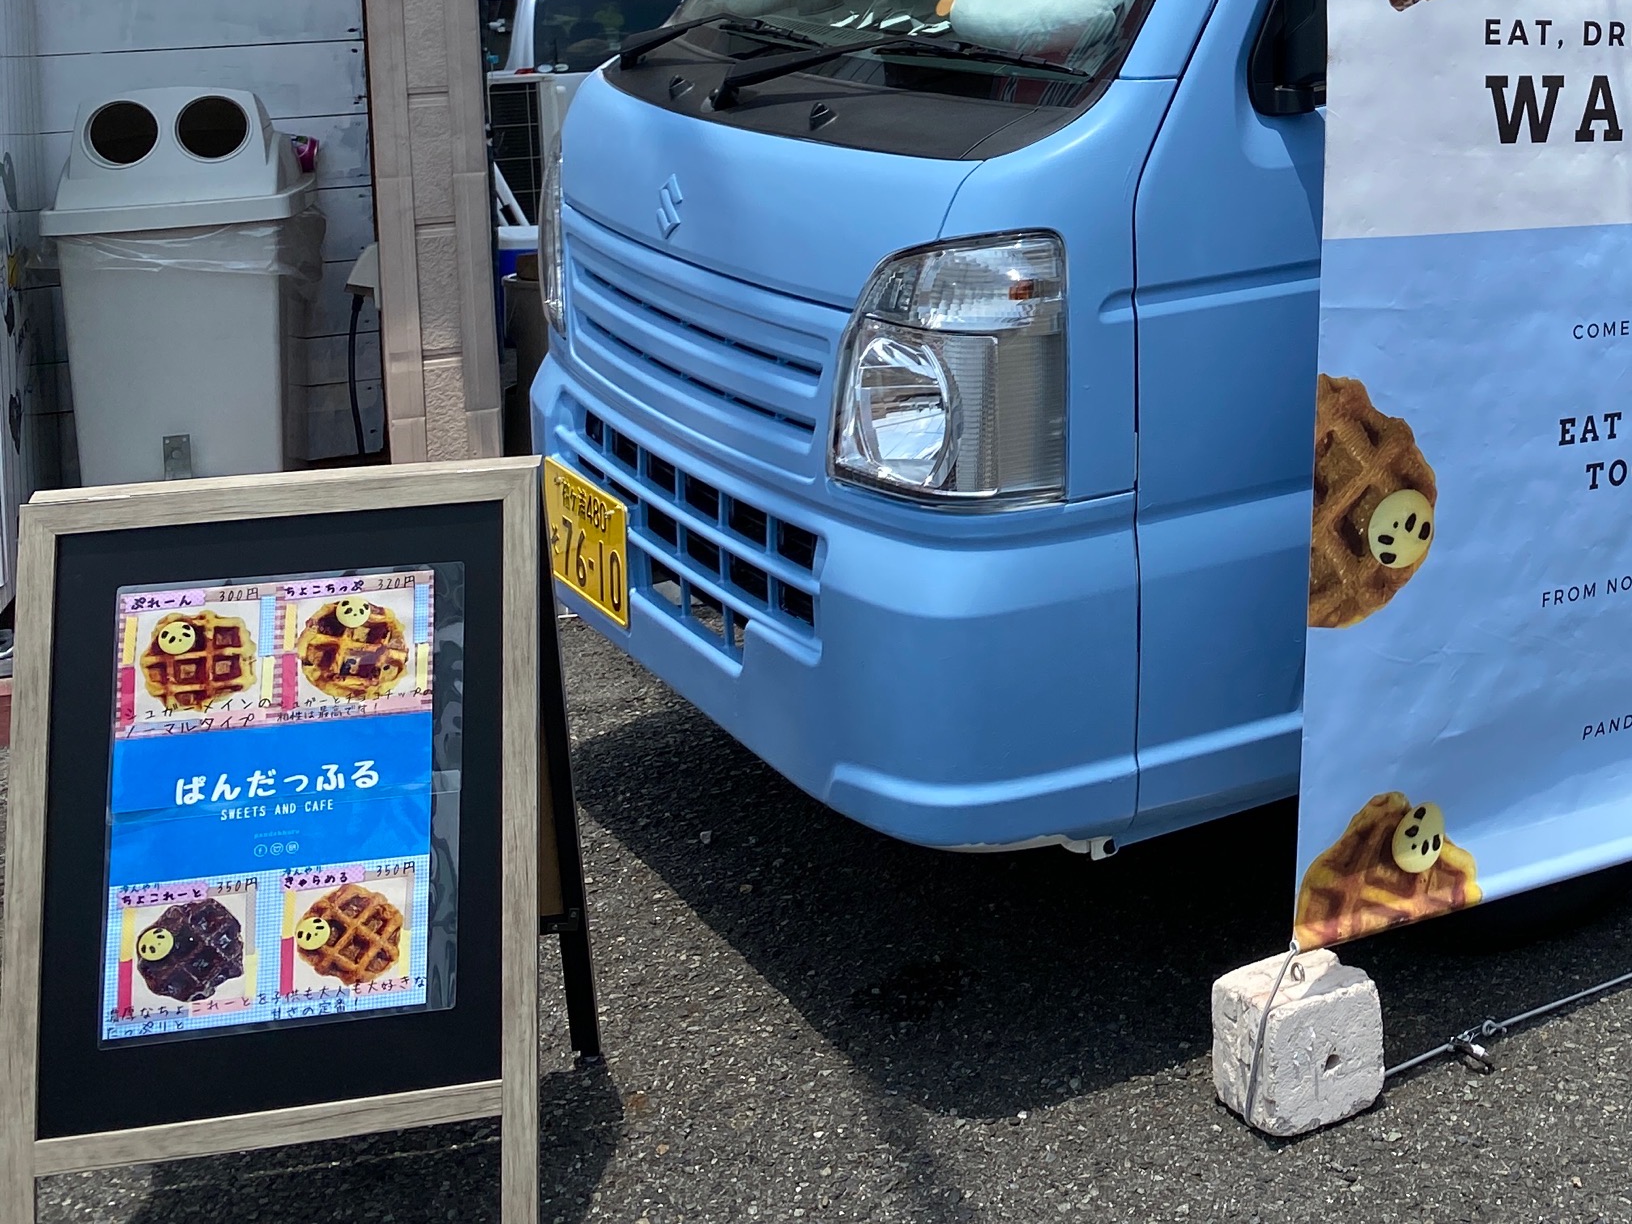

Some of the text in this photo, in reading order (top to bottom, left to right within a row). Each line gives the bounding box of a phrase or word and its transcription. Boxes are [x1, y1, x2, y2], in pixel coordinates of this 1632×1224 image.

[1484, 19, 1564, 50] EAT,
[1572, 319, 1631, 341] COME
[1558, 412, 1622, 448] EAT
[562, 515, 622, 612] 76-10
[284, 579, 365, 597] ちょこちっぷ
[378, 575, 416, 590] 320円
[131, 595, 192, 611] ぷれーん
[219, 587, 259, 602] 300円
[1540, 582, 1598, 609] FROM
[125, 713, 255, 739] ノーマルタイプ
[175, 759, 380, 806] ぱんだっふる
[220, 799, 334, 821] SWEETS AND CAFE
[376, 861, 416, 877] 350円
[216, 877, 258, 894] 350円
[284, 872, 348, 889] きゃらめる
[121, 888, 202, 906] ちょこれーと
[106, 1020, 185, 1040] たっぷりと
